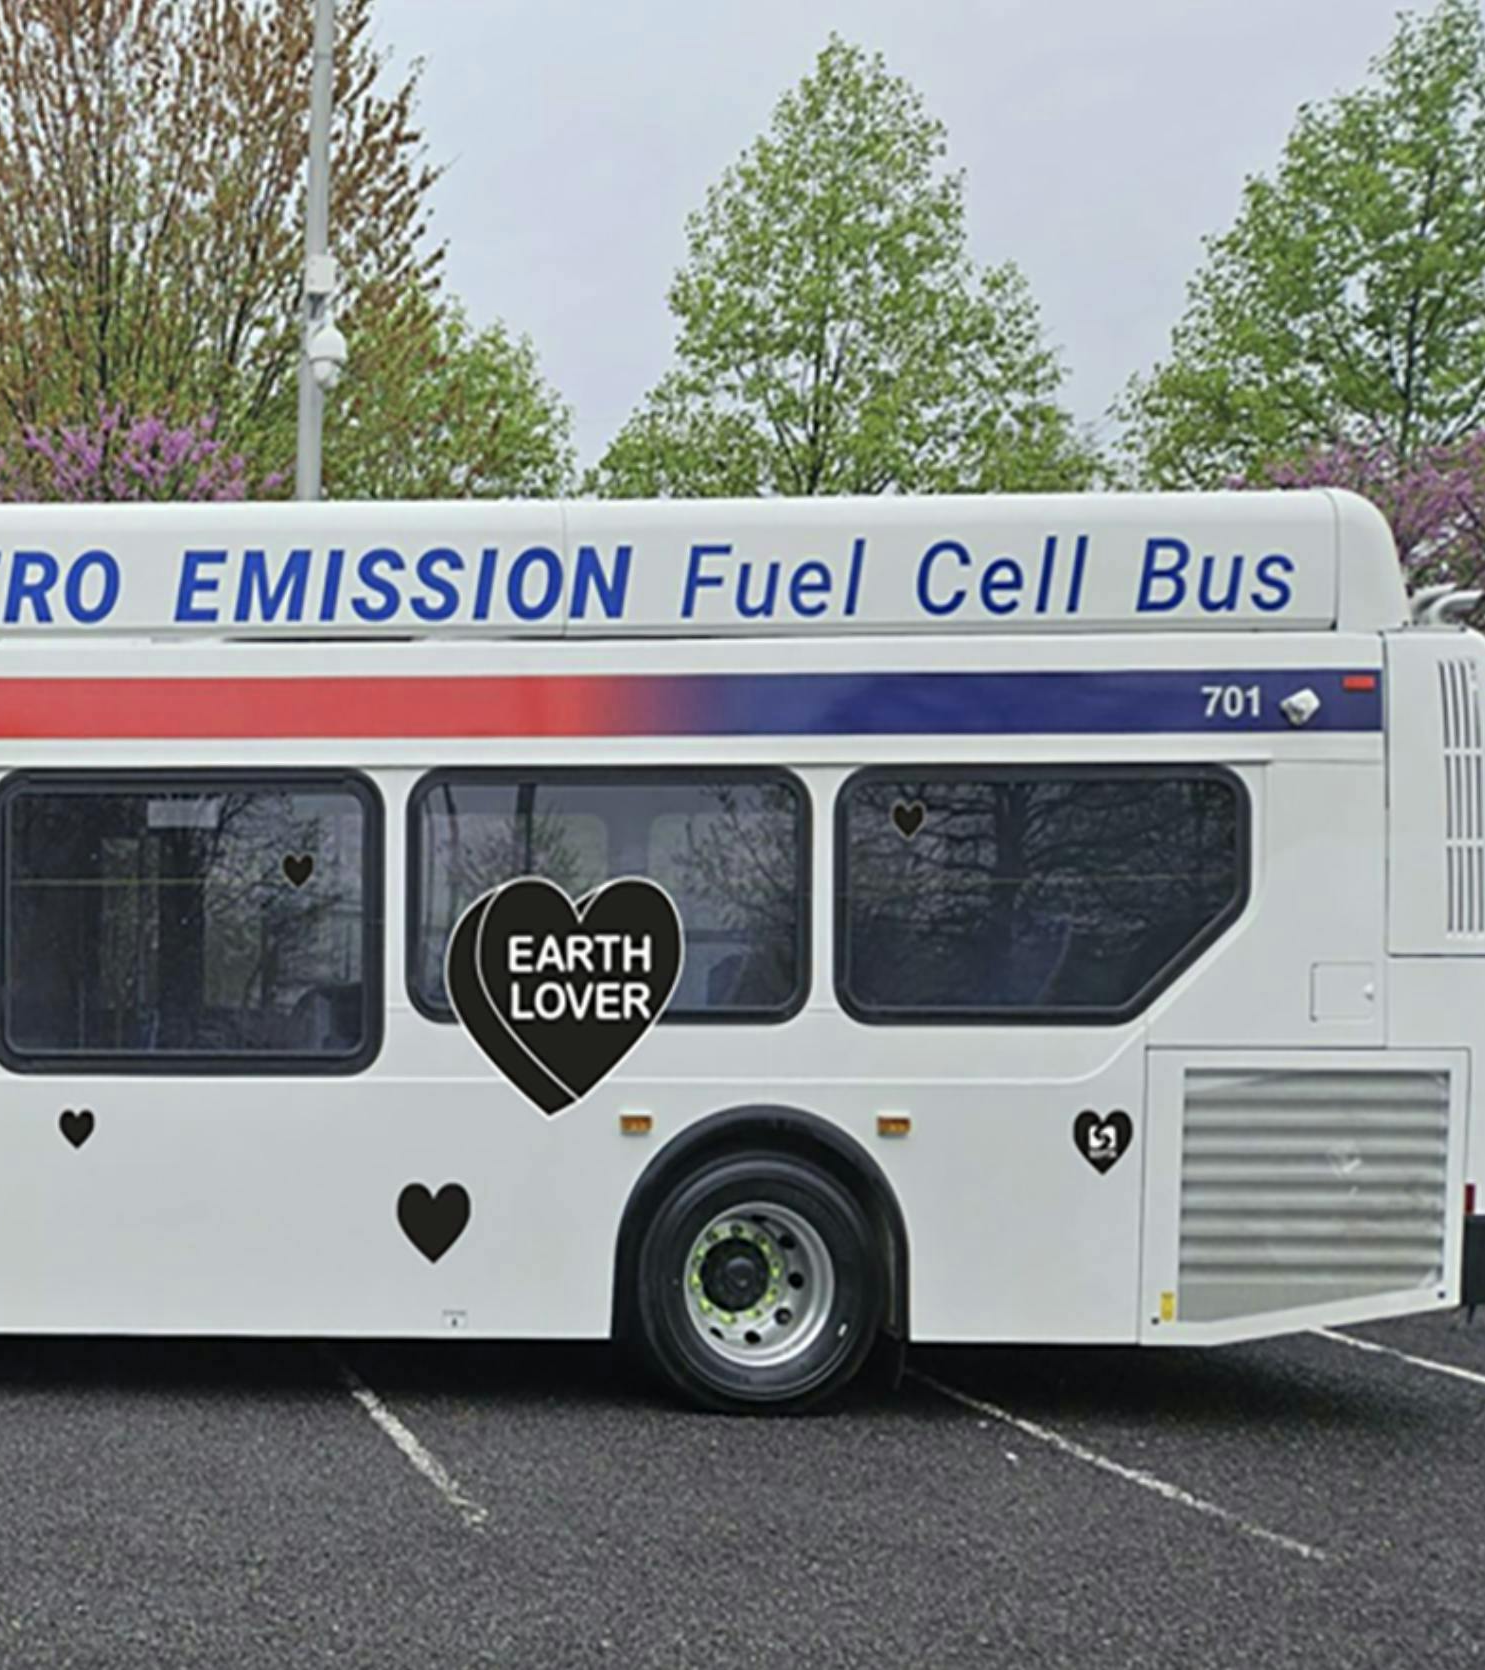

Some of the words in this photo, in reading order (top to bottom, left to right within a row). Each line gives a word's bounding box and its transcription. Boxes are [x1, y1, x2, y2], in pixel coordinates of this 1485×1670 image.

[174, 545, 632, 624] EMISSION
[681, 539, 865, 619] Fuel
[915, 535, 1088, 616] Cell
[1136, 538, 1295, 613] Bus
[1202, 685, 1260, 717] 701
[508, 934, 651, 973] EARTH
[511, 981, 652, 1021] LOVER
